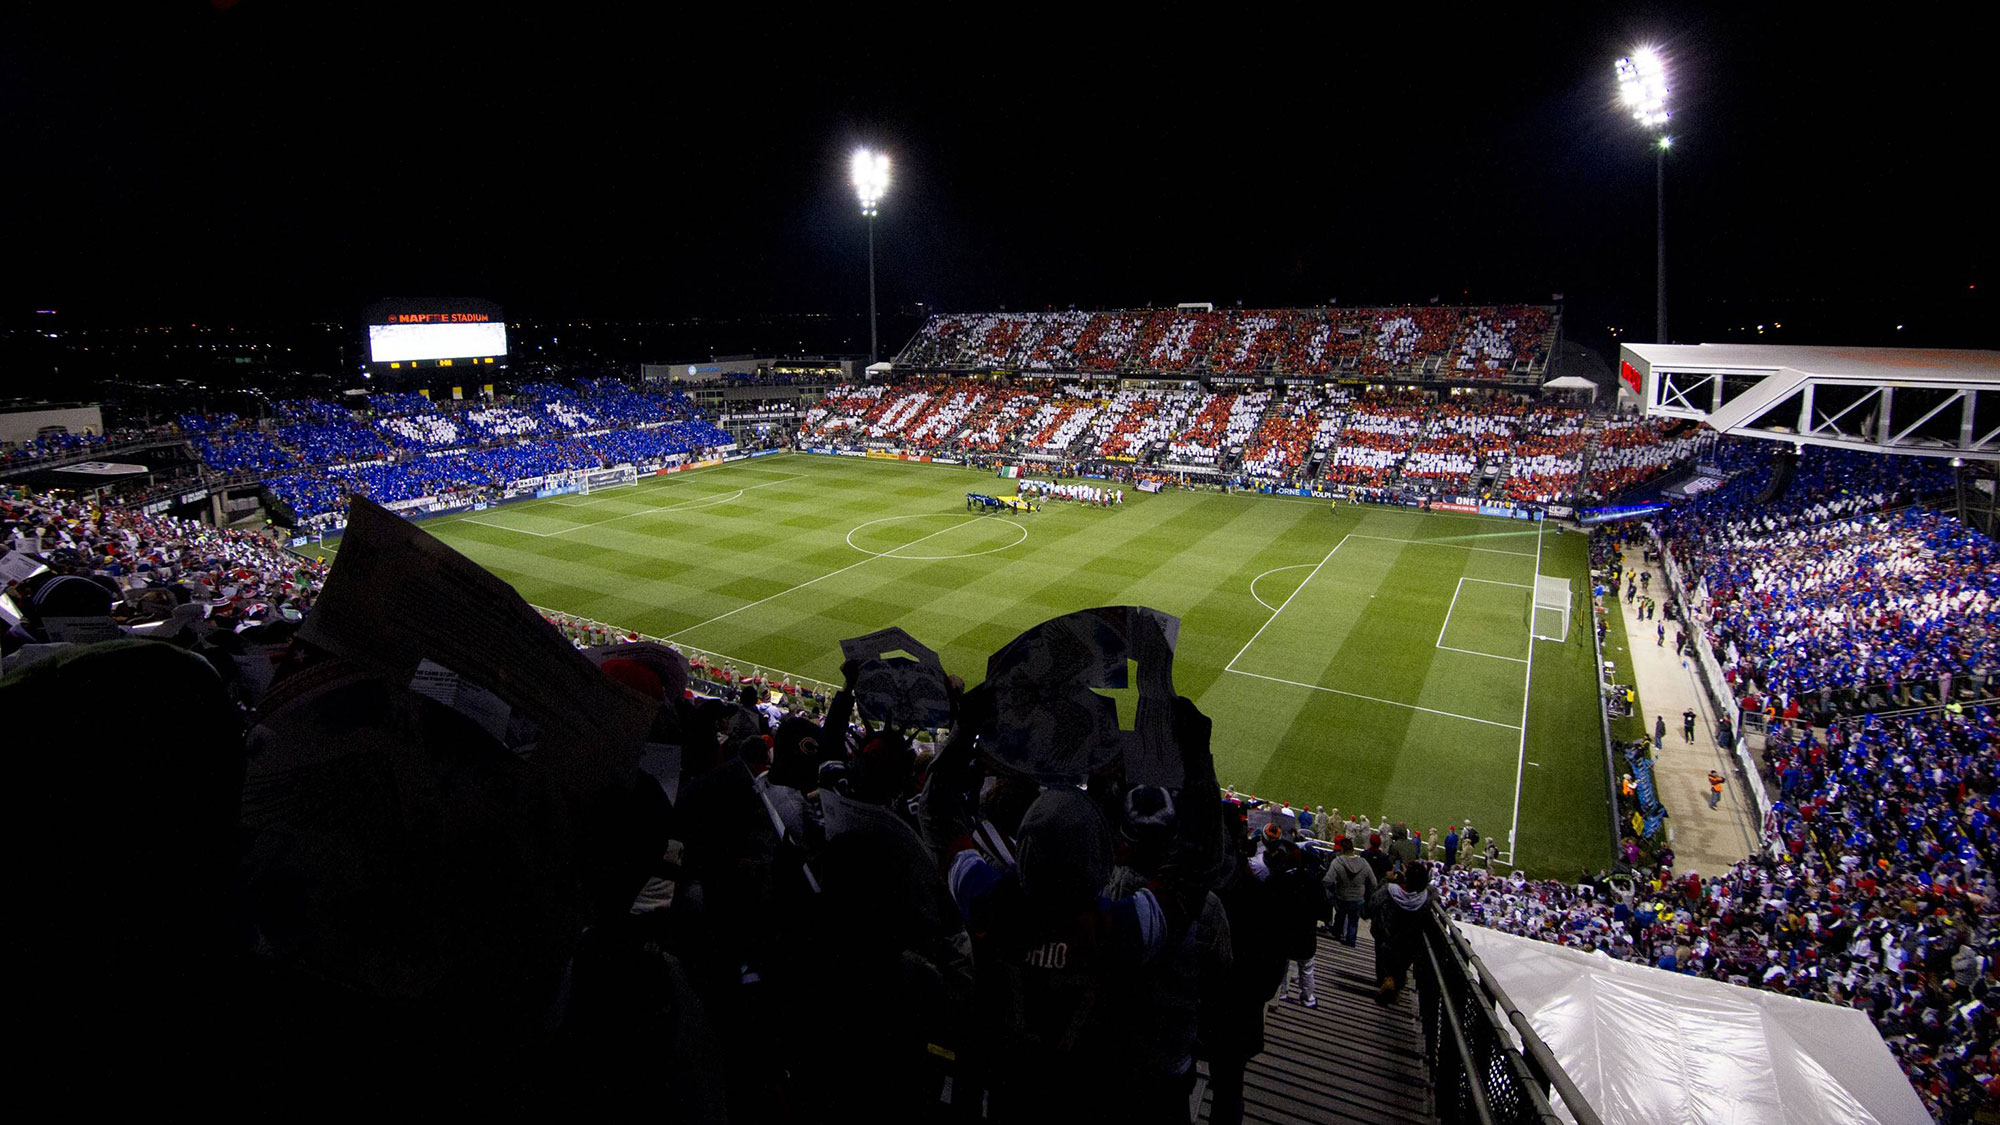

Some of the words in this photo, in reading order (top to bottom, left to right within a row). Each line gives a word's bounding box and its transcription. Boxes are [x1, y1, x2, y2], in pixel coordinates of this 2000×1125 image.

[451, 313, 489, 322] STADIUM
[1268, 486, 1300, 496] TORNE
[1311, 490, 1331, 499] VOLPI
[428, 501, 447, 511] UNA
[1455, 497, 1476, 506] ONE
[1025, 942, 1067, 969] HIO
